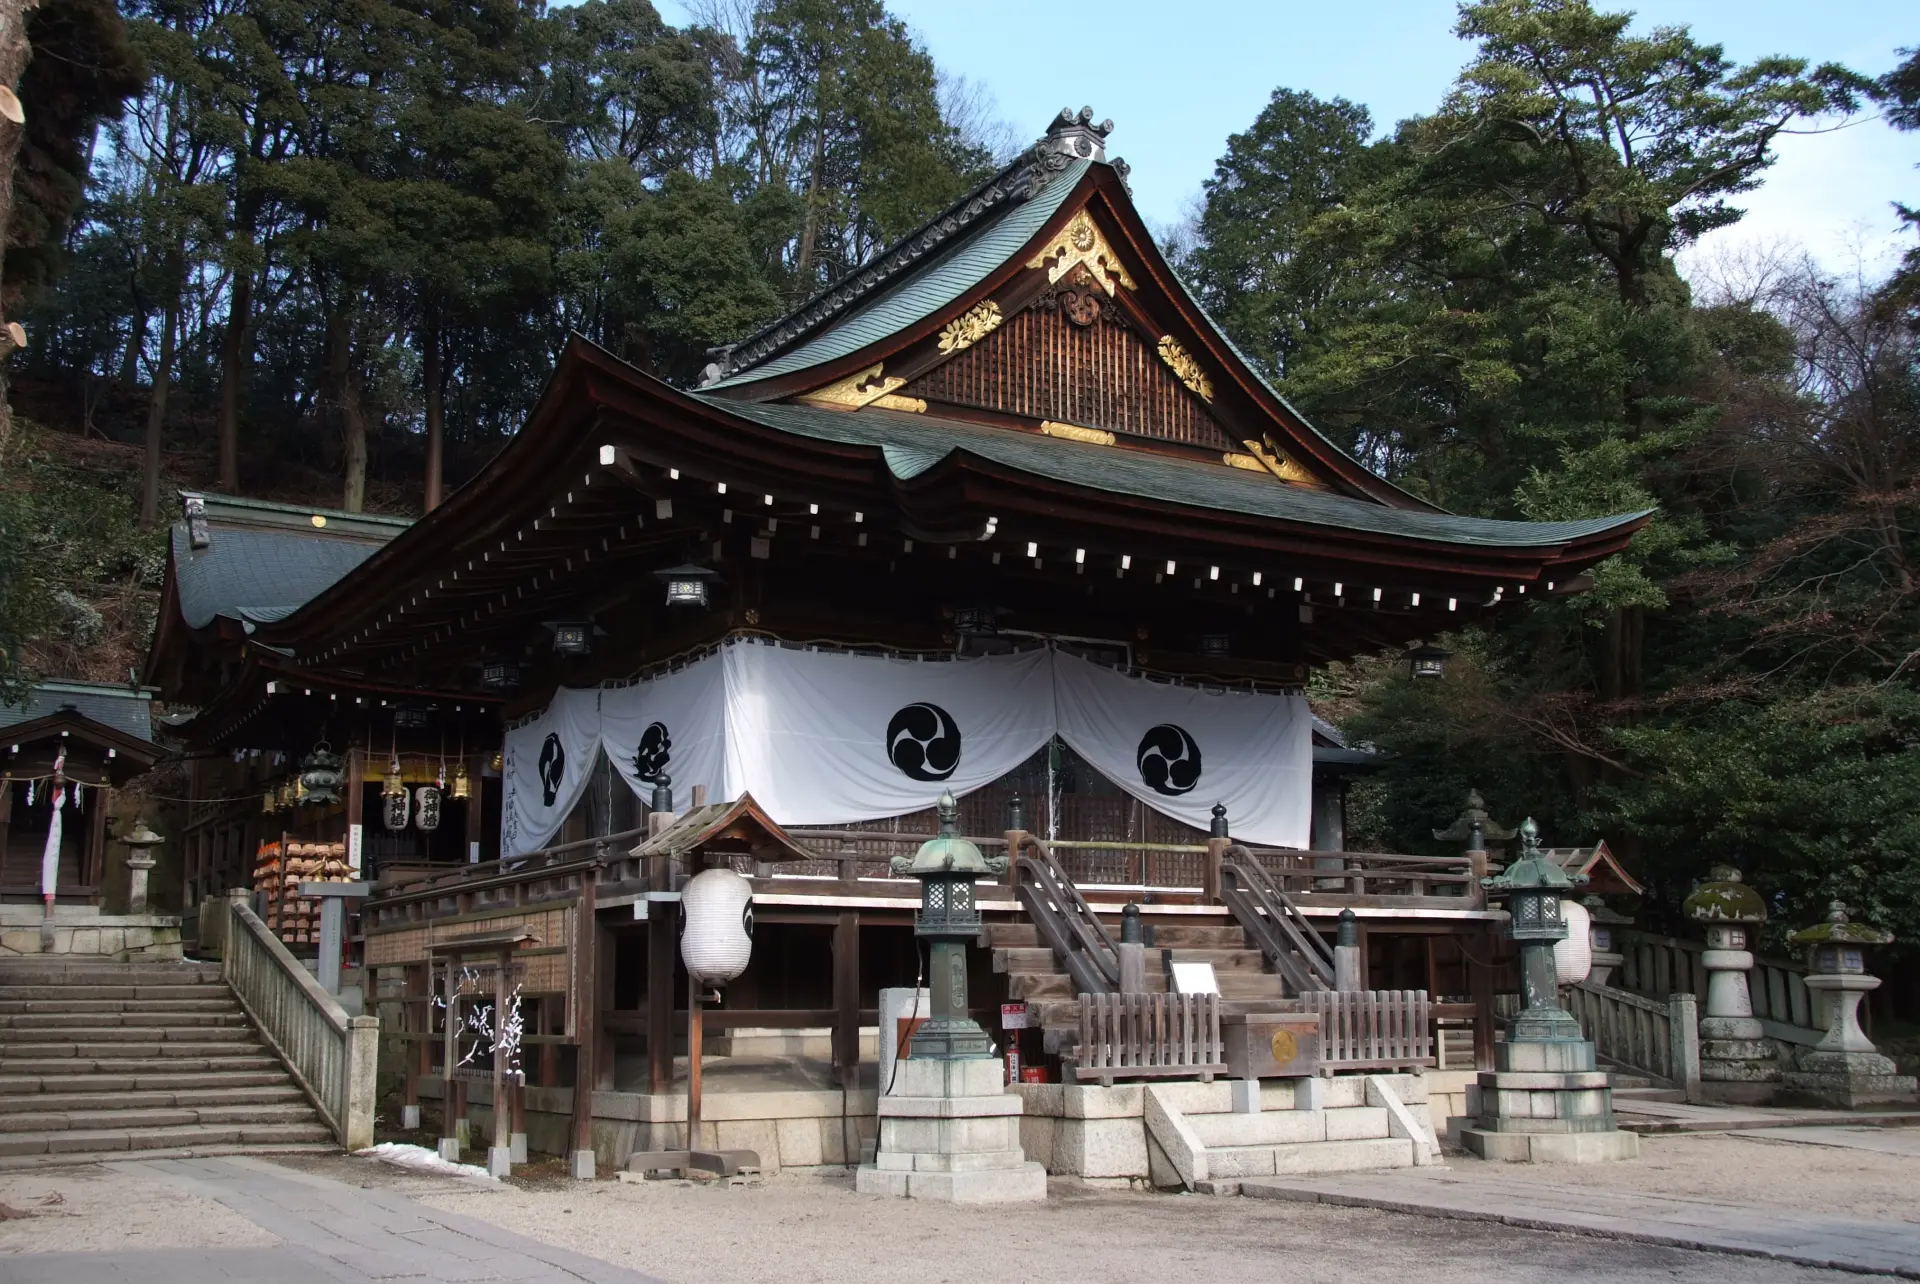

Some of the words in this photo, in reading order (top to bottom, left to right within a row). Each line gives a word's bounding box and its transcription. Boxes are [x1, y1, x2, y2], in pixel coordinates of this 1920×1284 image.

[391, 797, 406, 826] 神燈
[424, 788, 439, 827] 御神燈
